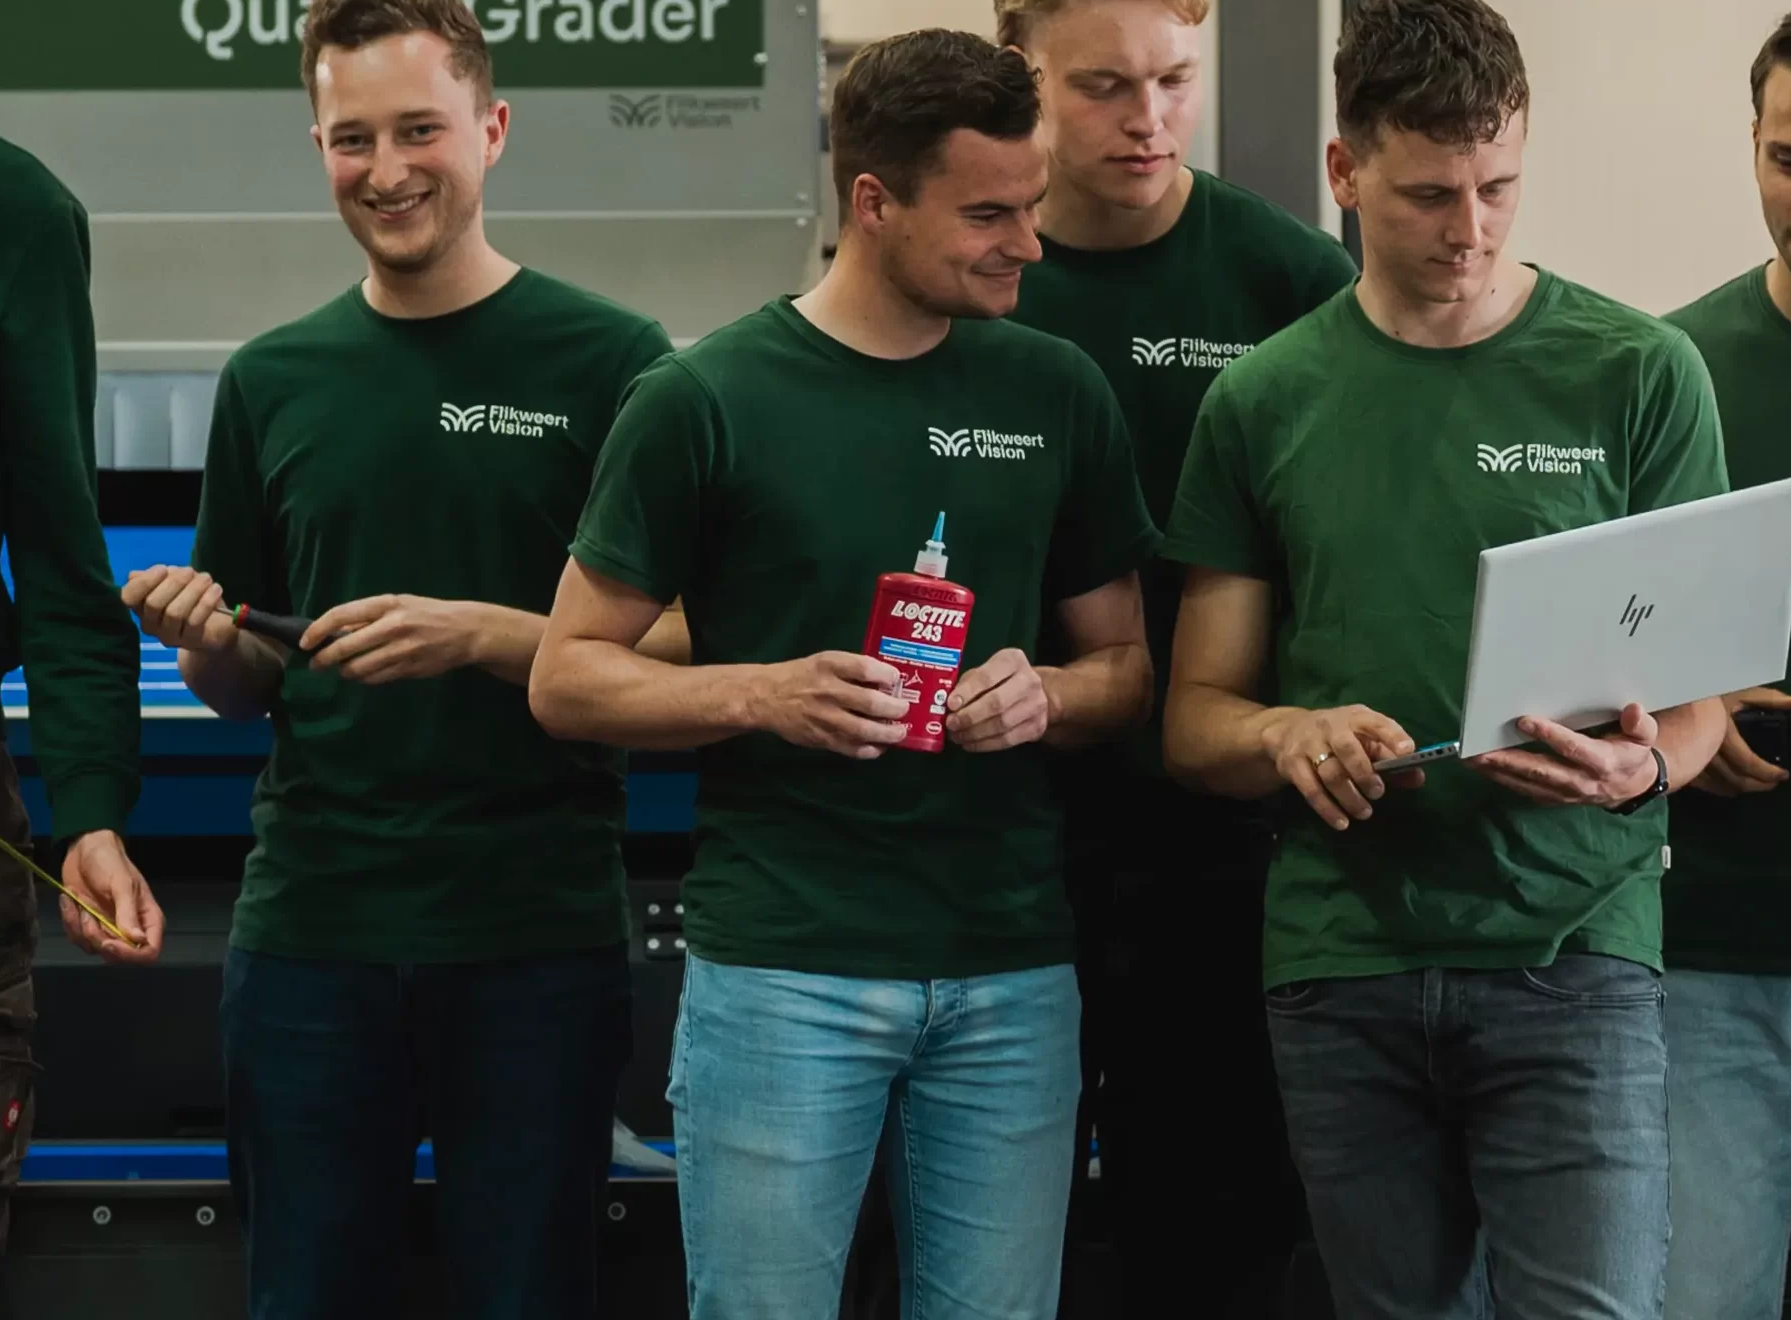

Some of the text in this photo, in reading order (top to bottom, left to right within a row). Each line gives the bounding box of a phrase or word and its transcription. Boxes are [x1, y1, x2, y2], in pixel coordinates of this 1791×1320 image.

[489, 405, 569, 429] Flikweert
[489, 419, 544, 437] Vision
[973, 429, 1045, 448] Flikweert
[975, 443, 1026, 460] Vision
[1526, 443, 1606, 462] Flikweert
[1526, 457, 1582, 475] Vision
[891, 600, 966, 628] LOCTITE
[911, 622, 943, 642] 243
